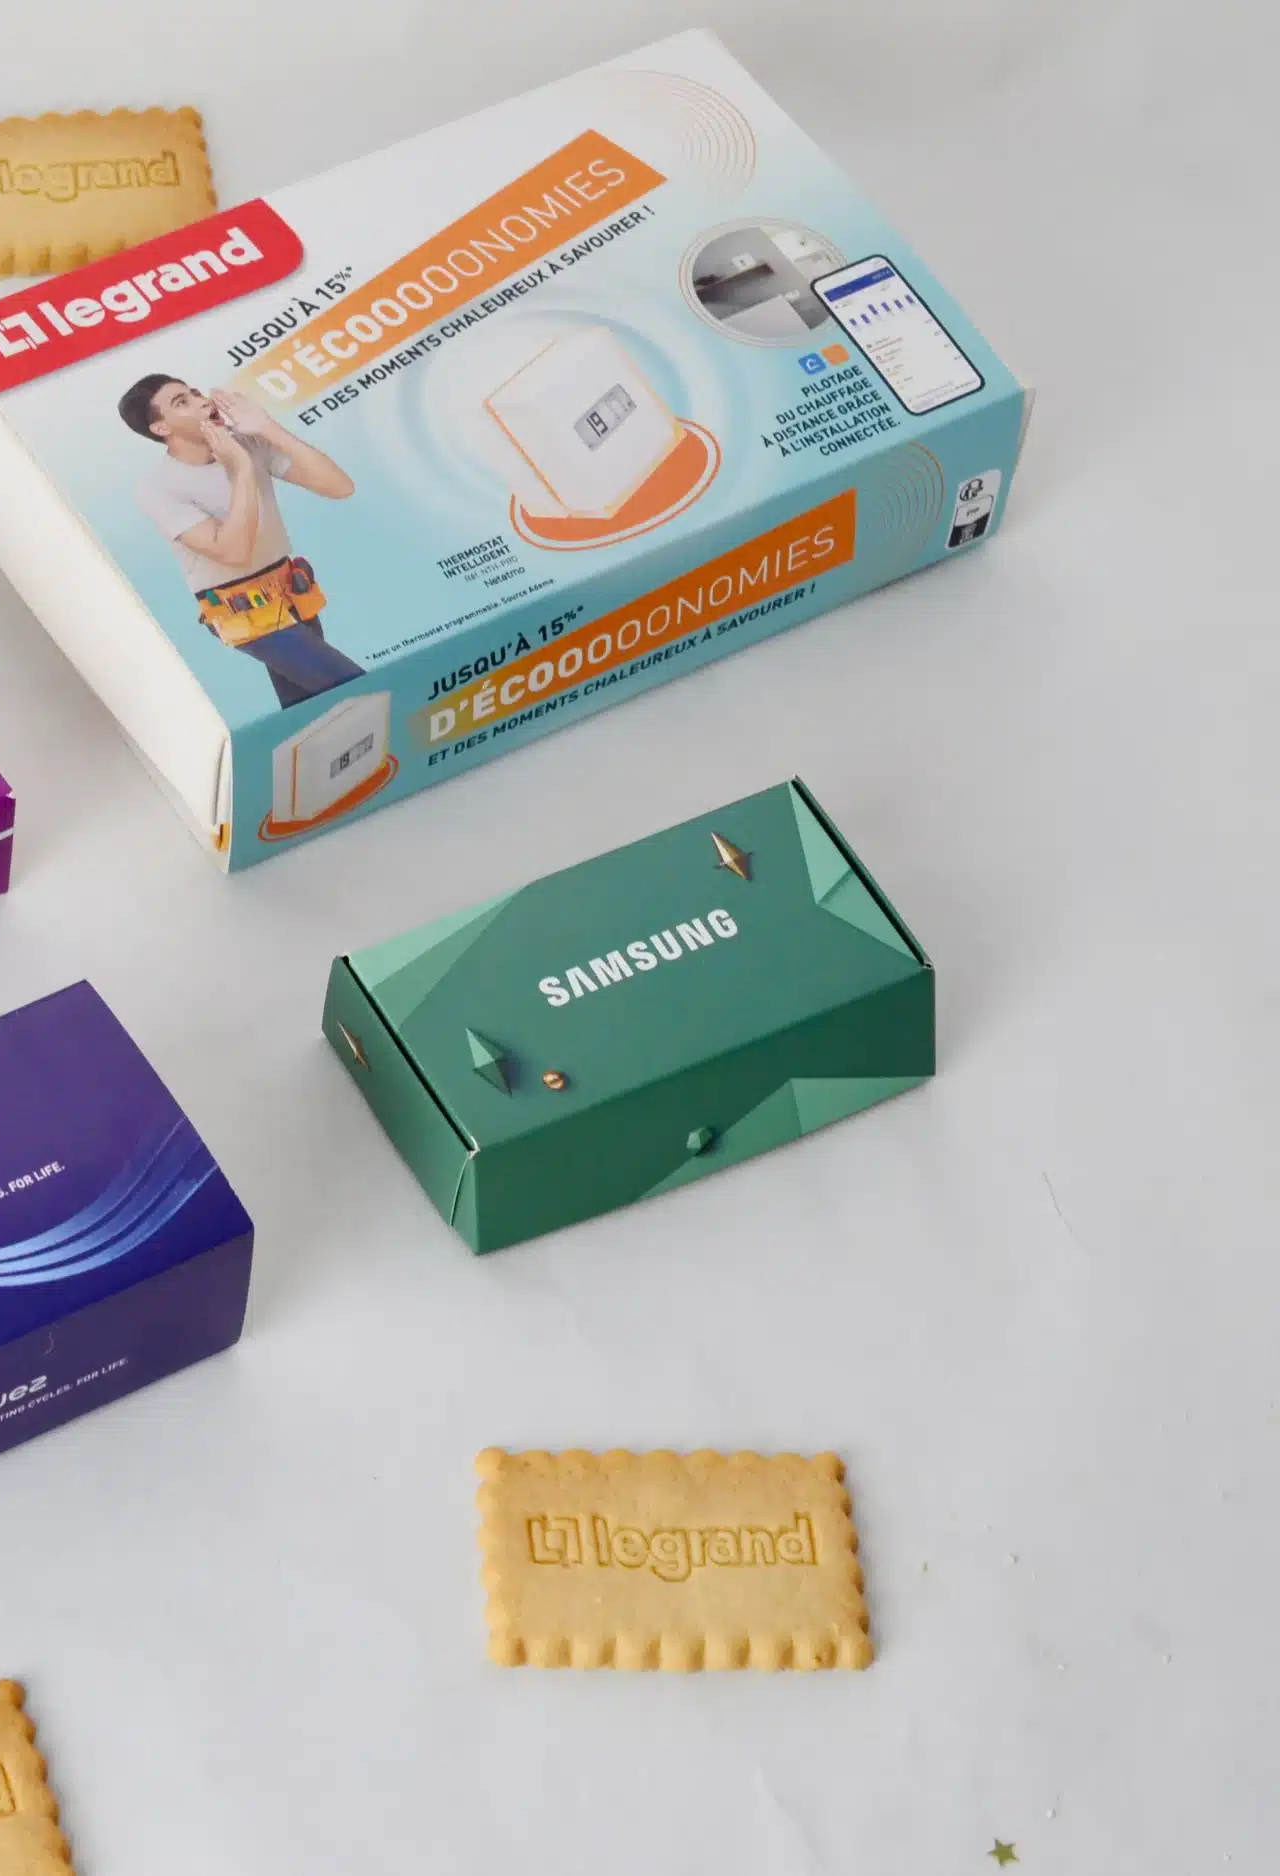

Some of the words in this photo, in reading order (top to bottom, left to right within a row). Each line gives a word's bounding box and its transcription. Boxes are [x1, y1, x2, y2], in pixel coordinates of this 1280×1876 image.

[38, 227, 264, 337] legrand
[255, 157, 627, 402] D'ÉCOOOOONOMIES
[226, 297, 320, 369] JUSQU'À
[297, 403, 324, 427] ET
[326, 384, 361, 413] DES
[357, 334, 443, 391] MOMENTS
[440, 268, 550, 339] CHALEUREUX
[544, 259, 564, 276] À
[559, 209, 644, 268] SAVOURER
[775, 410, 796, 425] DU
[796, 377, 873, 416] CHAUFFAGE
[800, 365, 863, 398] PILOTAGE
[761, 435, 774, 448] À
[772, 408, 838, 443] DISTANCE
[837, 390, 883, 416] GRÂCE
[778, 444, 791, 458] À
[790, 403, 892, 451] L'INSTALLATION
[819, 417, 901, 456] CONNECTÉE.
[437, 535, 505, 570] THERMOSTAT
[443, 544, 511, 580] INTELLIGENT
[483, 566, 526, 588] Netatmo
[391, 643, 401, 652] un
[401, 625, 444, 647] thermostat
[430, 524, 835, 743] D'ÉCOOOOONOMIES
[428, 632, 532, 700] JUSQU'À
[428, 751, 450, 767] ET
[454, 731, 488, 756] DES
[492, 690, 580, 738] MOMENTS
[582, 636, 698, 696] CHALEUREUX
[701, 624, 712, 643] À
[716, 587, 806, 636] SAVOURER
[537, 908, 740, 1008] SAMSUNG
[8, 1172, 35, 1193] FOR
[34, 1160, 66, 1182] LIFE.
[76, 1370, 100, 1387] FOR
[591, 1510, 819, 1583] legrand
